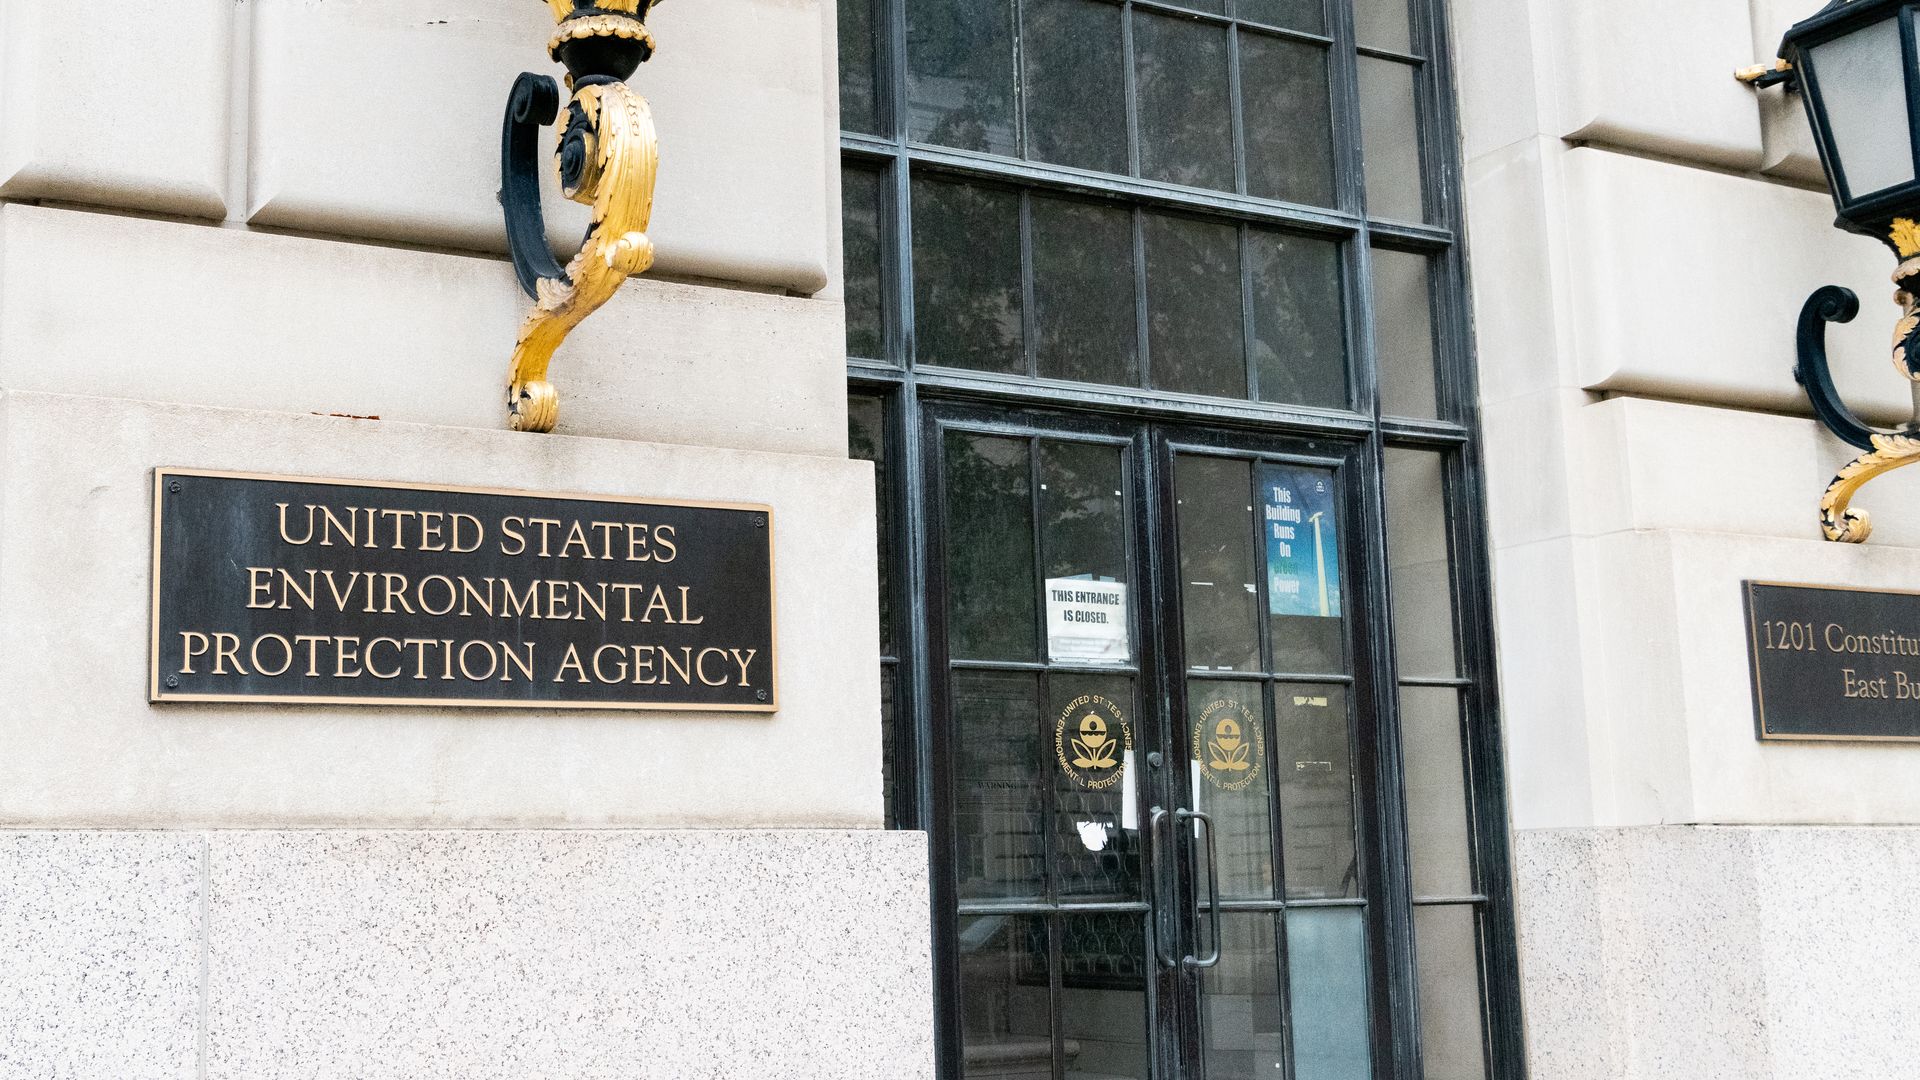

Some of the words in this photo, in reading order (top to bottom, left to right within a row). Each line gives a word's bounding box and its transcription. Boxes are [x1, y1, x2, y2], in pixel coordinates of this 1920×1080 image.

[1273, 487, 1291, 503] This
[1265, 504, 1301, 523] Building
[275, 503, 485, 553] UNITED
[501, 516, 678, 563] STATES
[1273, 523, 1295, 540] Runs
[1279, 541, 1291, 558] On
[246, 567, 705, 625] ENVIRONMENTAL
[1273, 577, 1300, 594] Power
[1052, 589, 1073, 602] THIS
[1075, 591, 1119, 605] ENTRANCE
[1063, 610, 1073, 622] IS
[1075, 610, 1109, 624] CLOSED.
[1763, 620, 1817, 651] 1201
[178, 631, 537, 683] PROTECTION
[553, 641, 758, 688] AGENCY
[1841, 668, 1889, 699] East
[1062, 695, 1089, 718] UNITED
[1093, 695, 1121, 718] STTES
[1200, 700, 1225, 721] UNITED
[1227, 700, 1254, 722] STTES
[1055, 719, 1085, 787] ENVIRONMENTL
[1087, 761, 1128, 789] PROTECTION
[1120, 721, 1132, 753] GENCY
